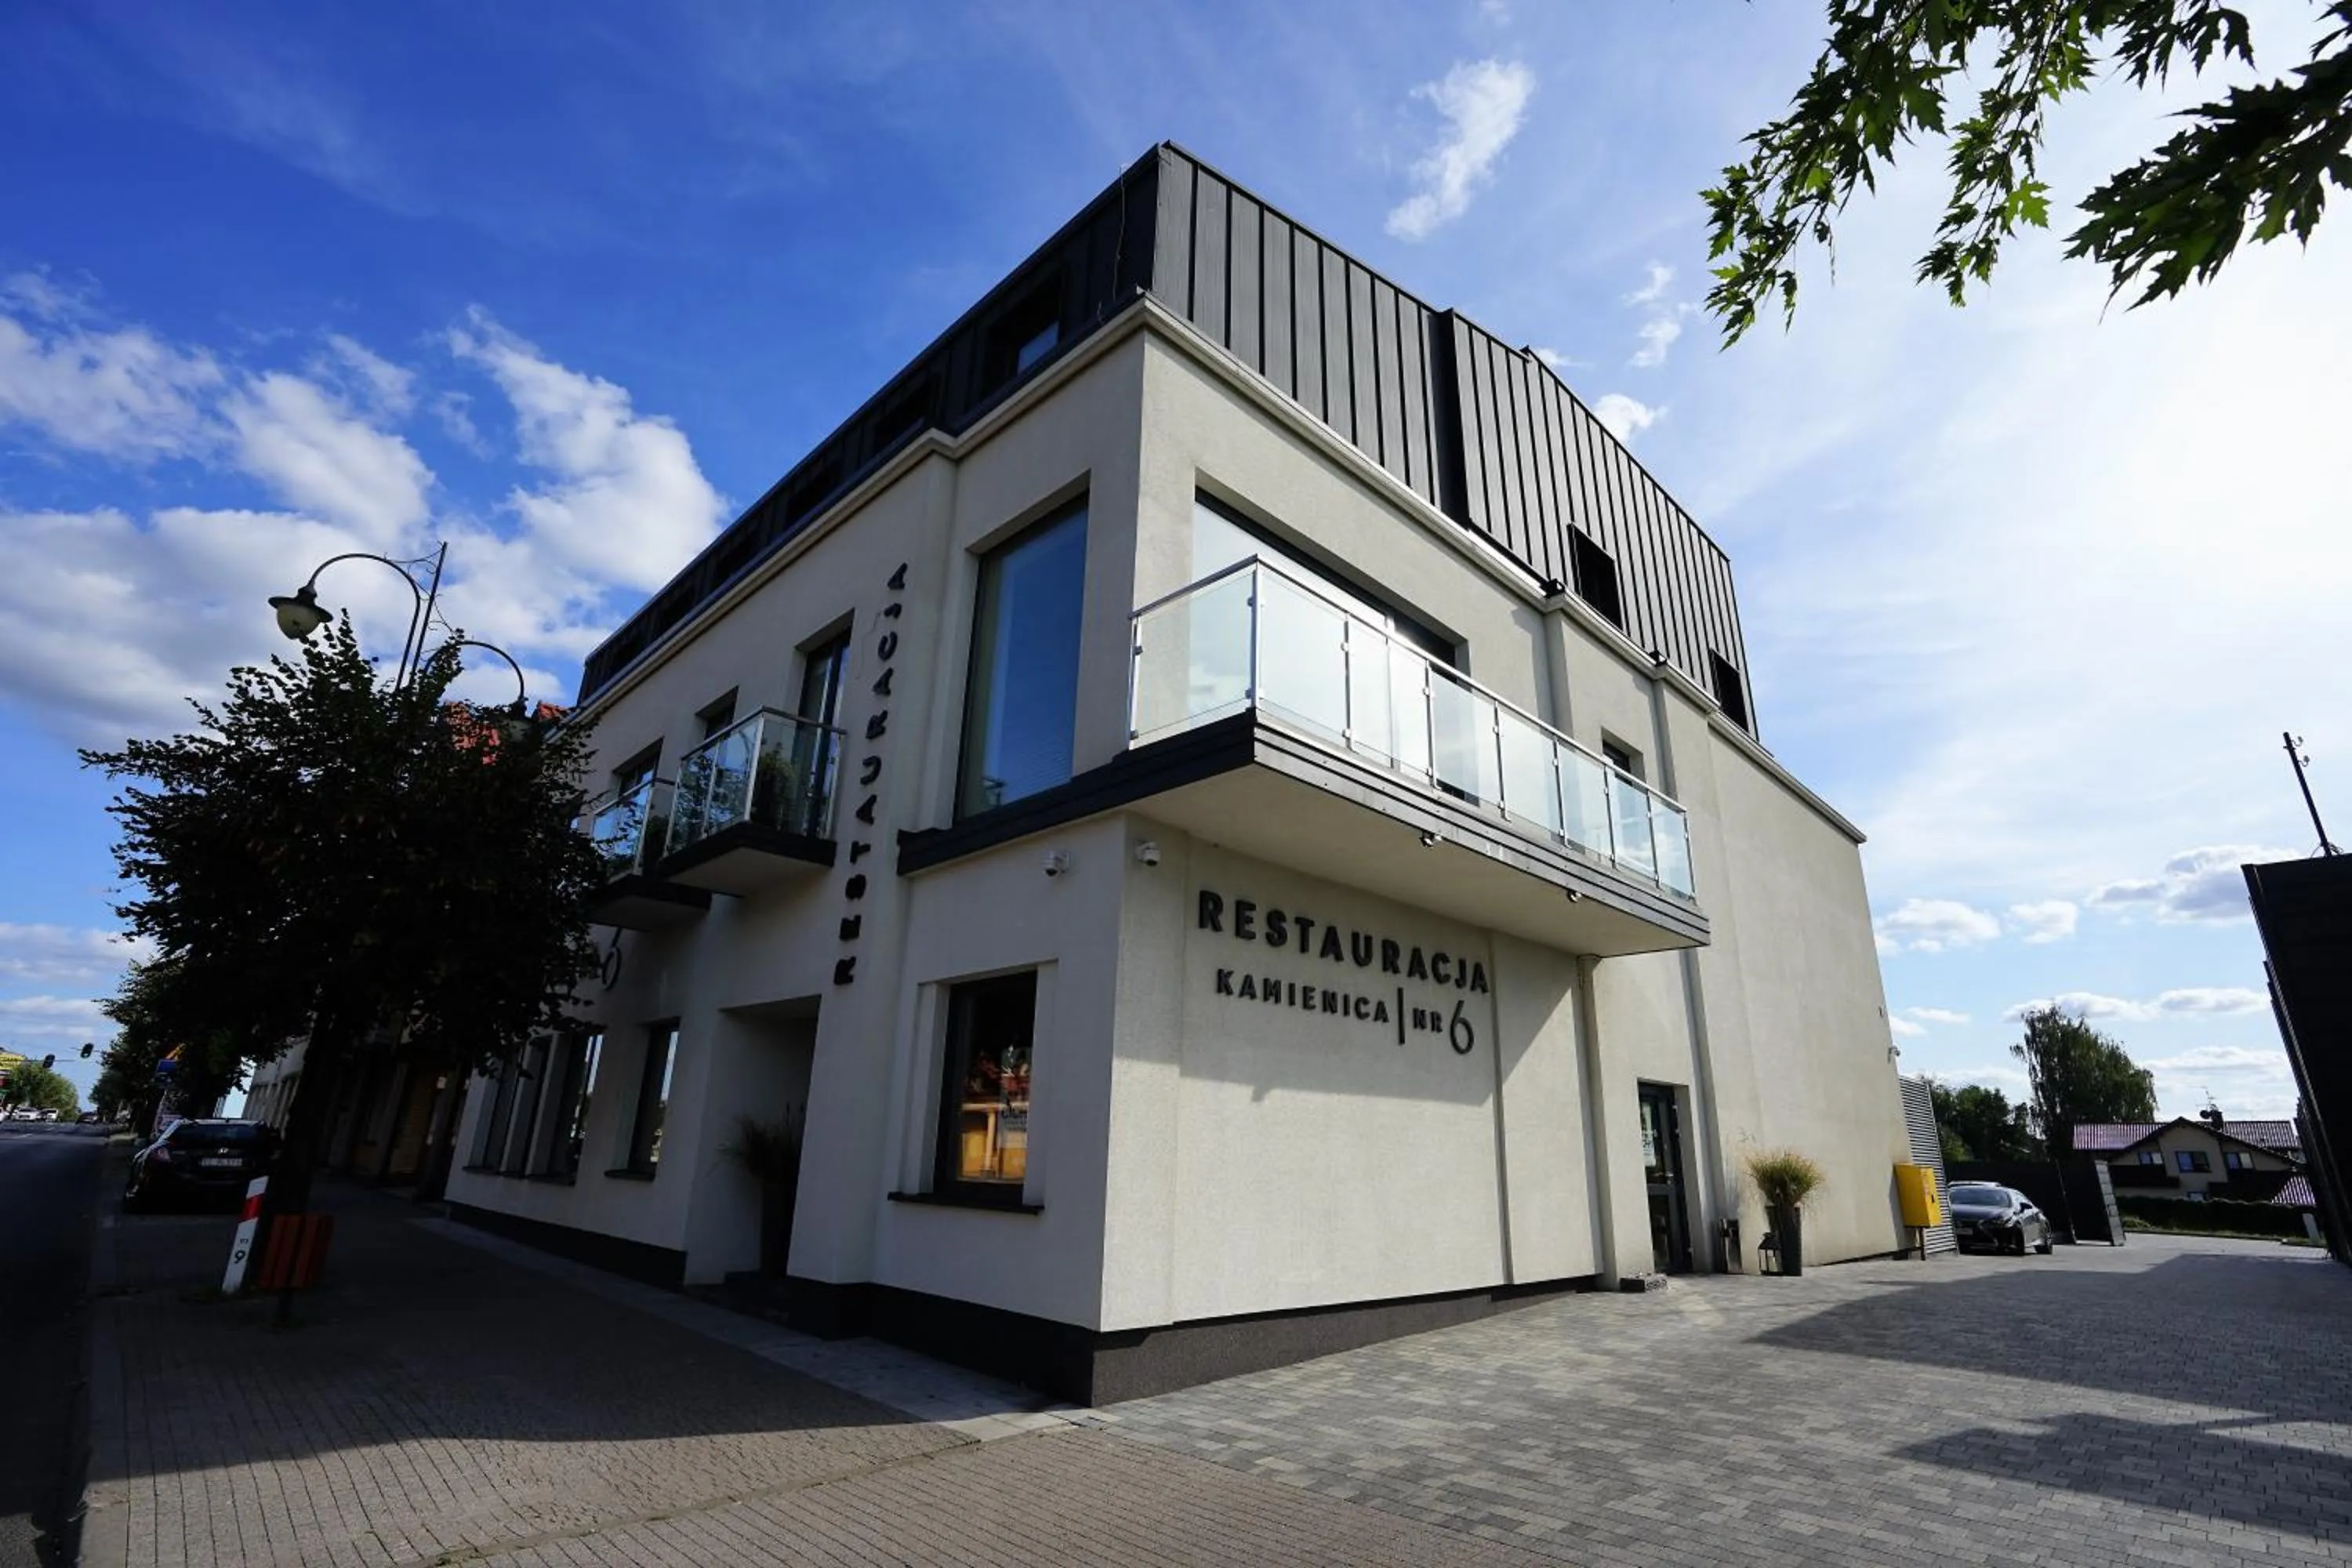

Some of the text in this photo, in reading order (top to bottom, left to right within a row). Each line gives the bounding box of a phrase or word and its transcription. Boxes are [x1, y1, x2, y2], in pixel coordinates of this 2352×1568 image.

[833, 562, 908, 985] RESTAURACJA
[1199, 889, 1489, 994] RESTAURACJA
[1217, 967, 1475, 1055] KAMIENICA NR 6
[234, 1250, 245, 1264] 9
